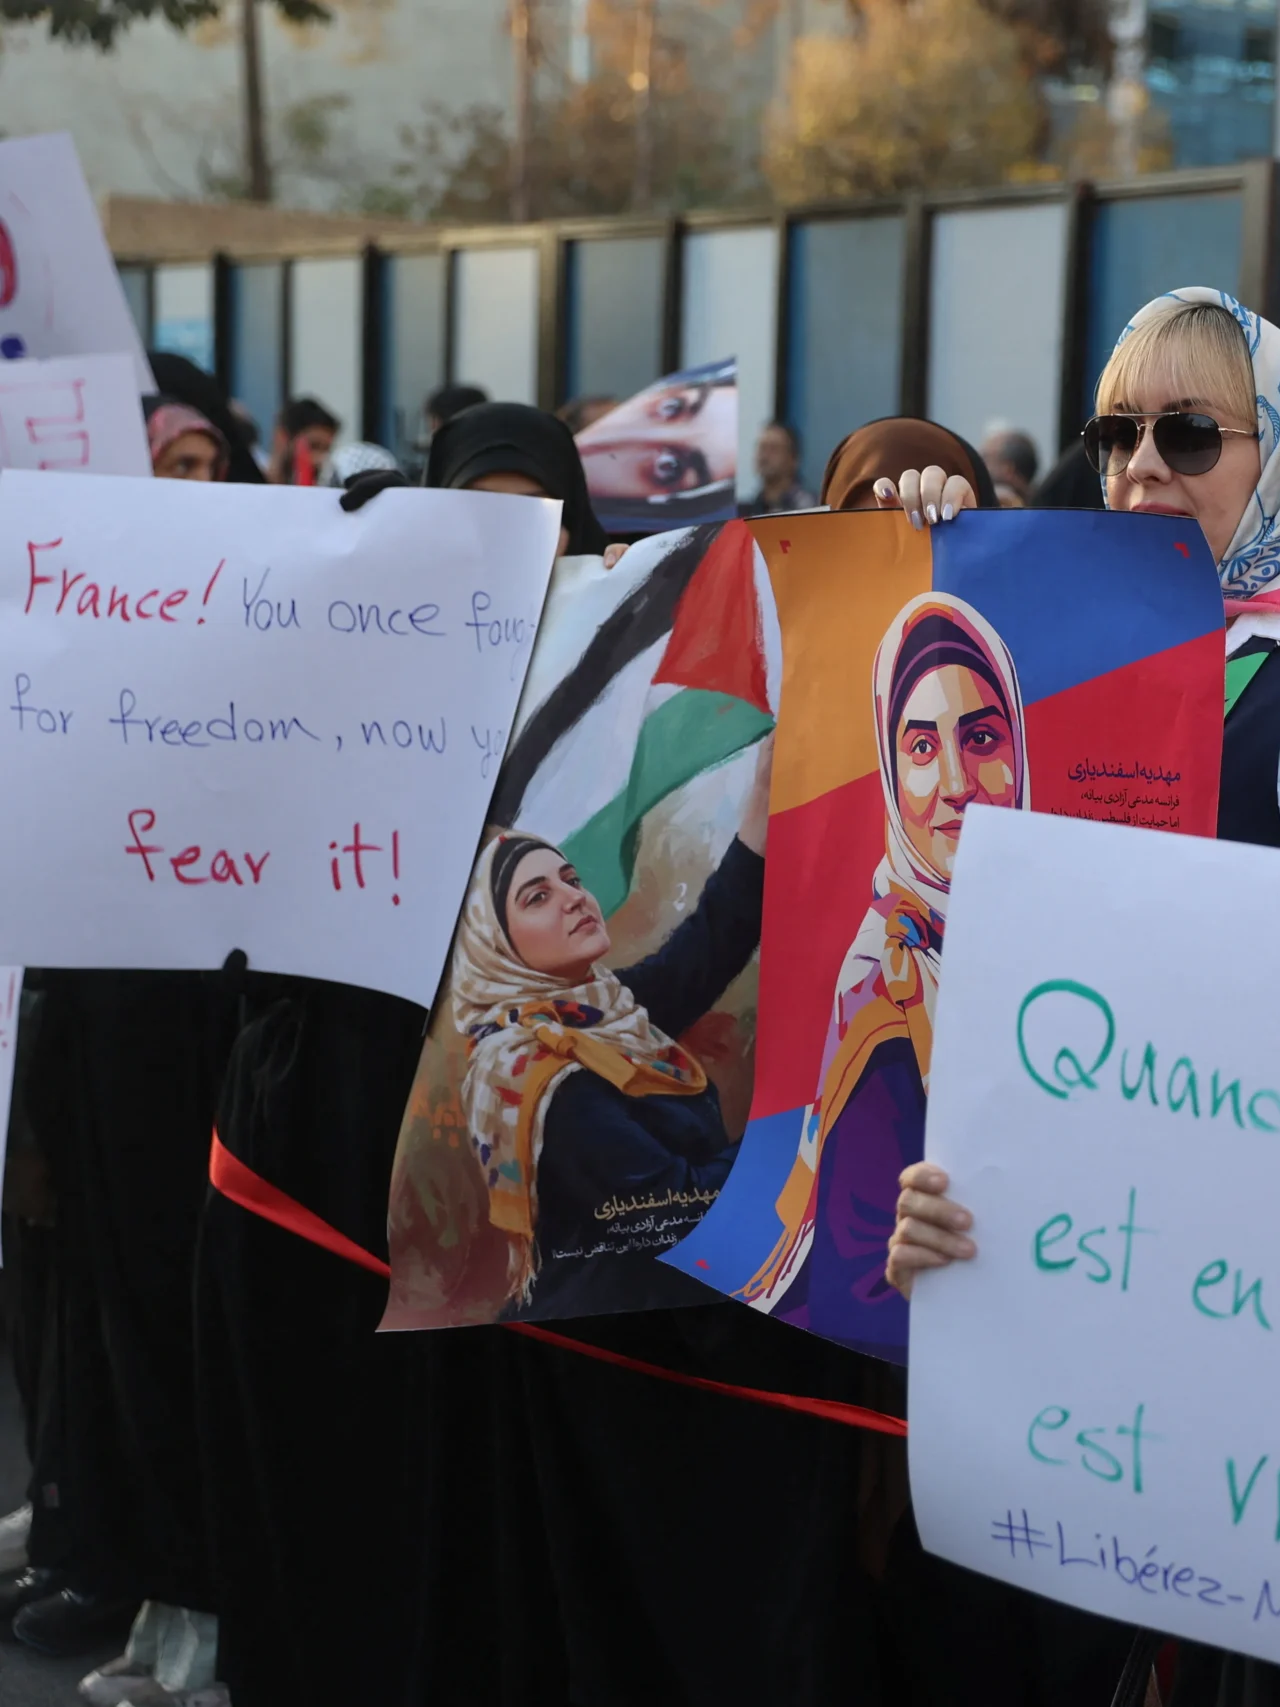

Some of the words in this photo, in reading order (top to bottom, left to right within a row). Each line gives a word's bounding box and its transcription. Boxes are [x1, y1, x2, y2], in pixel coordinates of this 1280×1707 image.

[24, 537, 226, 626] France!
[242, 567, 300, 633] You
[327, 600, 447, 637] once
[9, 672, 74, 736] for
[108, 688, 344, 752] freedom,
[361, 716, 447, 755] now
[1067, 757, 1139, 783] اسفندیاری
[1139, 764, 1182, 787] مهدیه
[1103, 788, 1129, 807] آزادی
[1128, 794, 1154, 809] مدعی
[1154, 795, 1180, 811] فرانسه
[1169, 815, 1180, 829] اما
[125, 808, 271, 886] fear
[327, 822, 400, 907] it!
[593, 1188, 673, 1221] اسفندیاری
[629, 1214, 656, 1233] آزادی
[654, 1215, 684, 1232] مدعی
[1028, 1184, 1160, 1295] est
[1188, 1255, 1274, 1333] en
[1022, 1400, 1171, 1497] est
